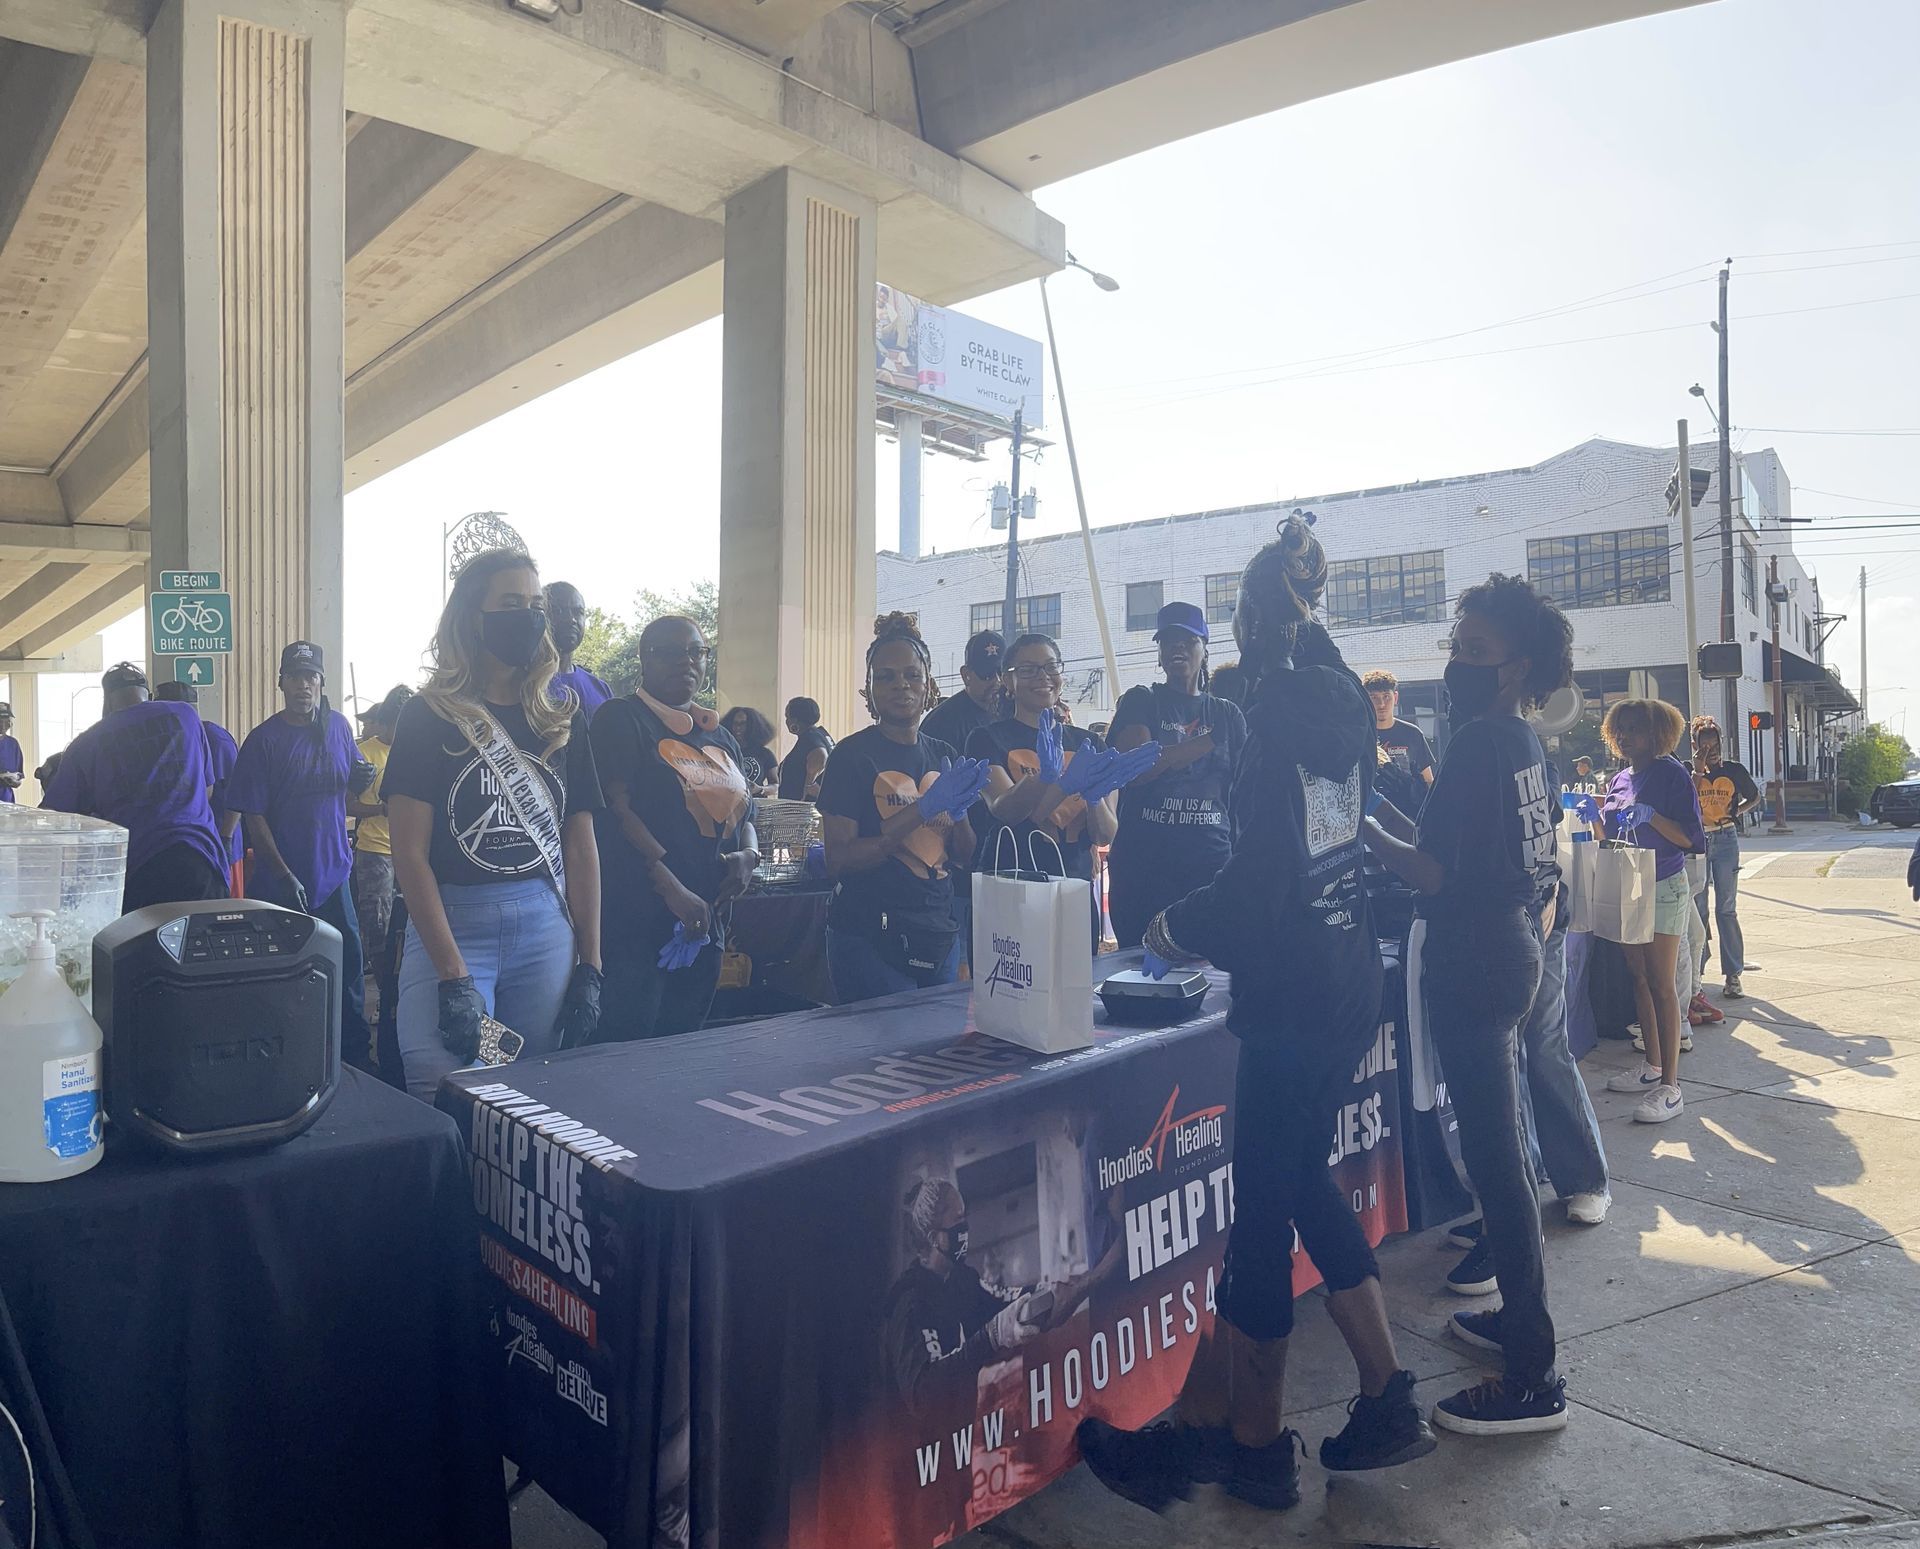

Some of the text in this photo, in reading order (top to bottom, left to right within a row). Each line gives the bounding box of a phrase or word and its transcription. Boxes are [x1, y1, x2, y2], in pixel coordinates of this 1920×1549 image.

[961, 354, 1031, 387] BY THE CLAW
[968, 341, 1024, 371] GRAB LIFE
[976, 386, 999, 401] WHITE
[173, 575, 209, 587] BEGIN
[160, 637, 227, 650] BIKE ROUTE
[489, 743, 519, 780] Elite
[509, 771, 541, 816] Texas
[1141, 808, 1167, 824] MAKE
[1168, 812, 1175, 825] A
[1161, 798, 1183, 812] JOIN
[1186, 799, 1199, 811] US
[992, 932, 1021, 959] Hoodies
[1001, 954, 1032, 988] Healing
[61, 1067, 85, 1079] Hand
[61, 1073, 97, 1089] Sanitizer
[465, 1083, 538, 1107] BUY
[503, 1104, 551, 1118] A
[472, 1100, 584, 1223] HELP THE
[1098, 1115, 1222, 1191] Hoodies Healing
[1174, 1147, 1225, 1176] FOUNDATION
[470, 1157, 601, 1296] OMELESS.
[1124, 1179, 1206, 1282] HELP
[506, 1303, 538, 1341] Hoodies
[523, 1329, 555, 1376] Healing
[558, 1369, 606, 1423] BELIEVE
